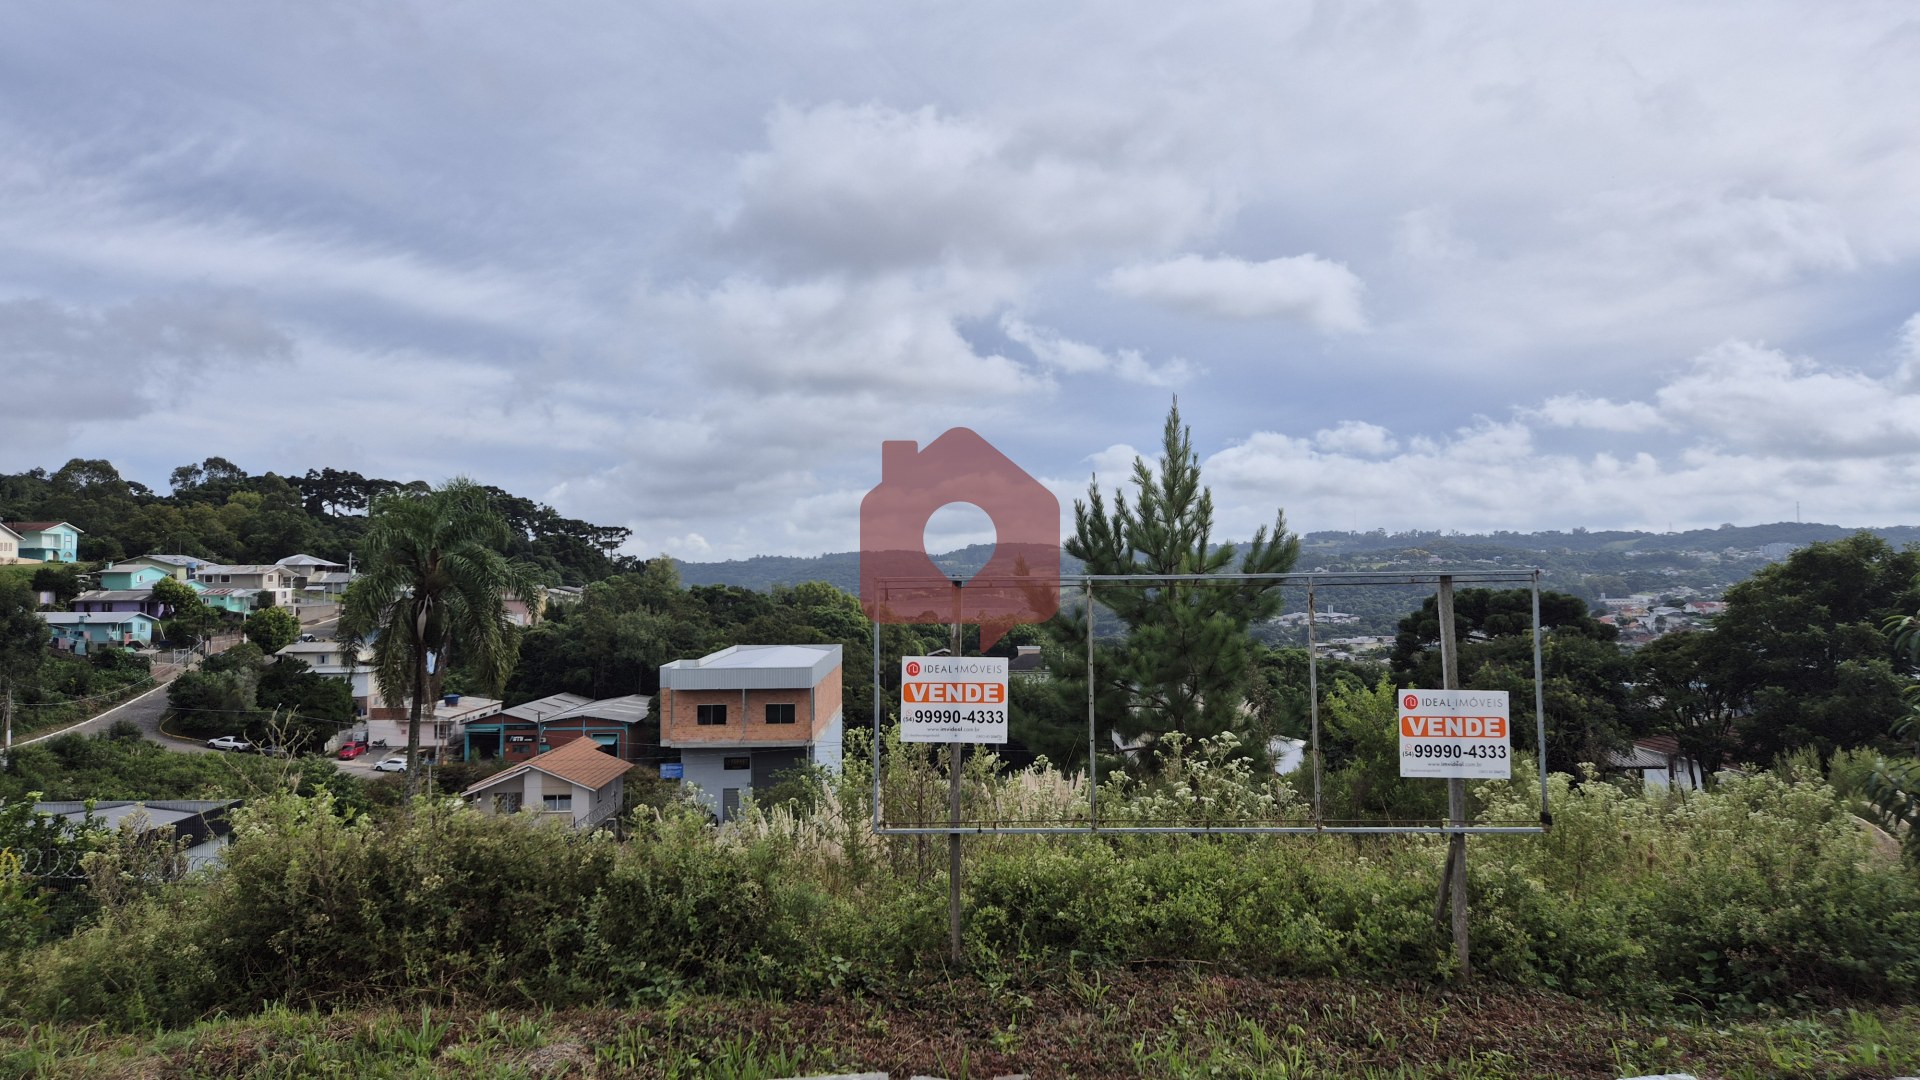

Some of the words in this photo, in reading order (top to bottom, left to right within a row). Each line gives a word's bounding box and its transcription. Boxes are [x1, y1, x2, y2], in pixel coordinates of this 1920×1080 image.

[924, 664, 953, 674] IDEAL
[956, 663, 1003, 674] IMÓVEIS
[909, 683, 999, 703] VENDE
[1421, 697, 1452, 707] IDEAL
[1455, 696, 1504, 708] IMÓVEIS
[914, 709, 1004, 724] 99990-4333
[1407, 717, 1501, 737] VENDE
[1402, 750, 1415, 758] (54)
[1414, 744, 1507, 759] 99990-4333
